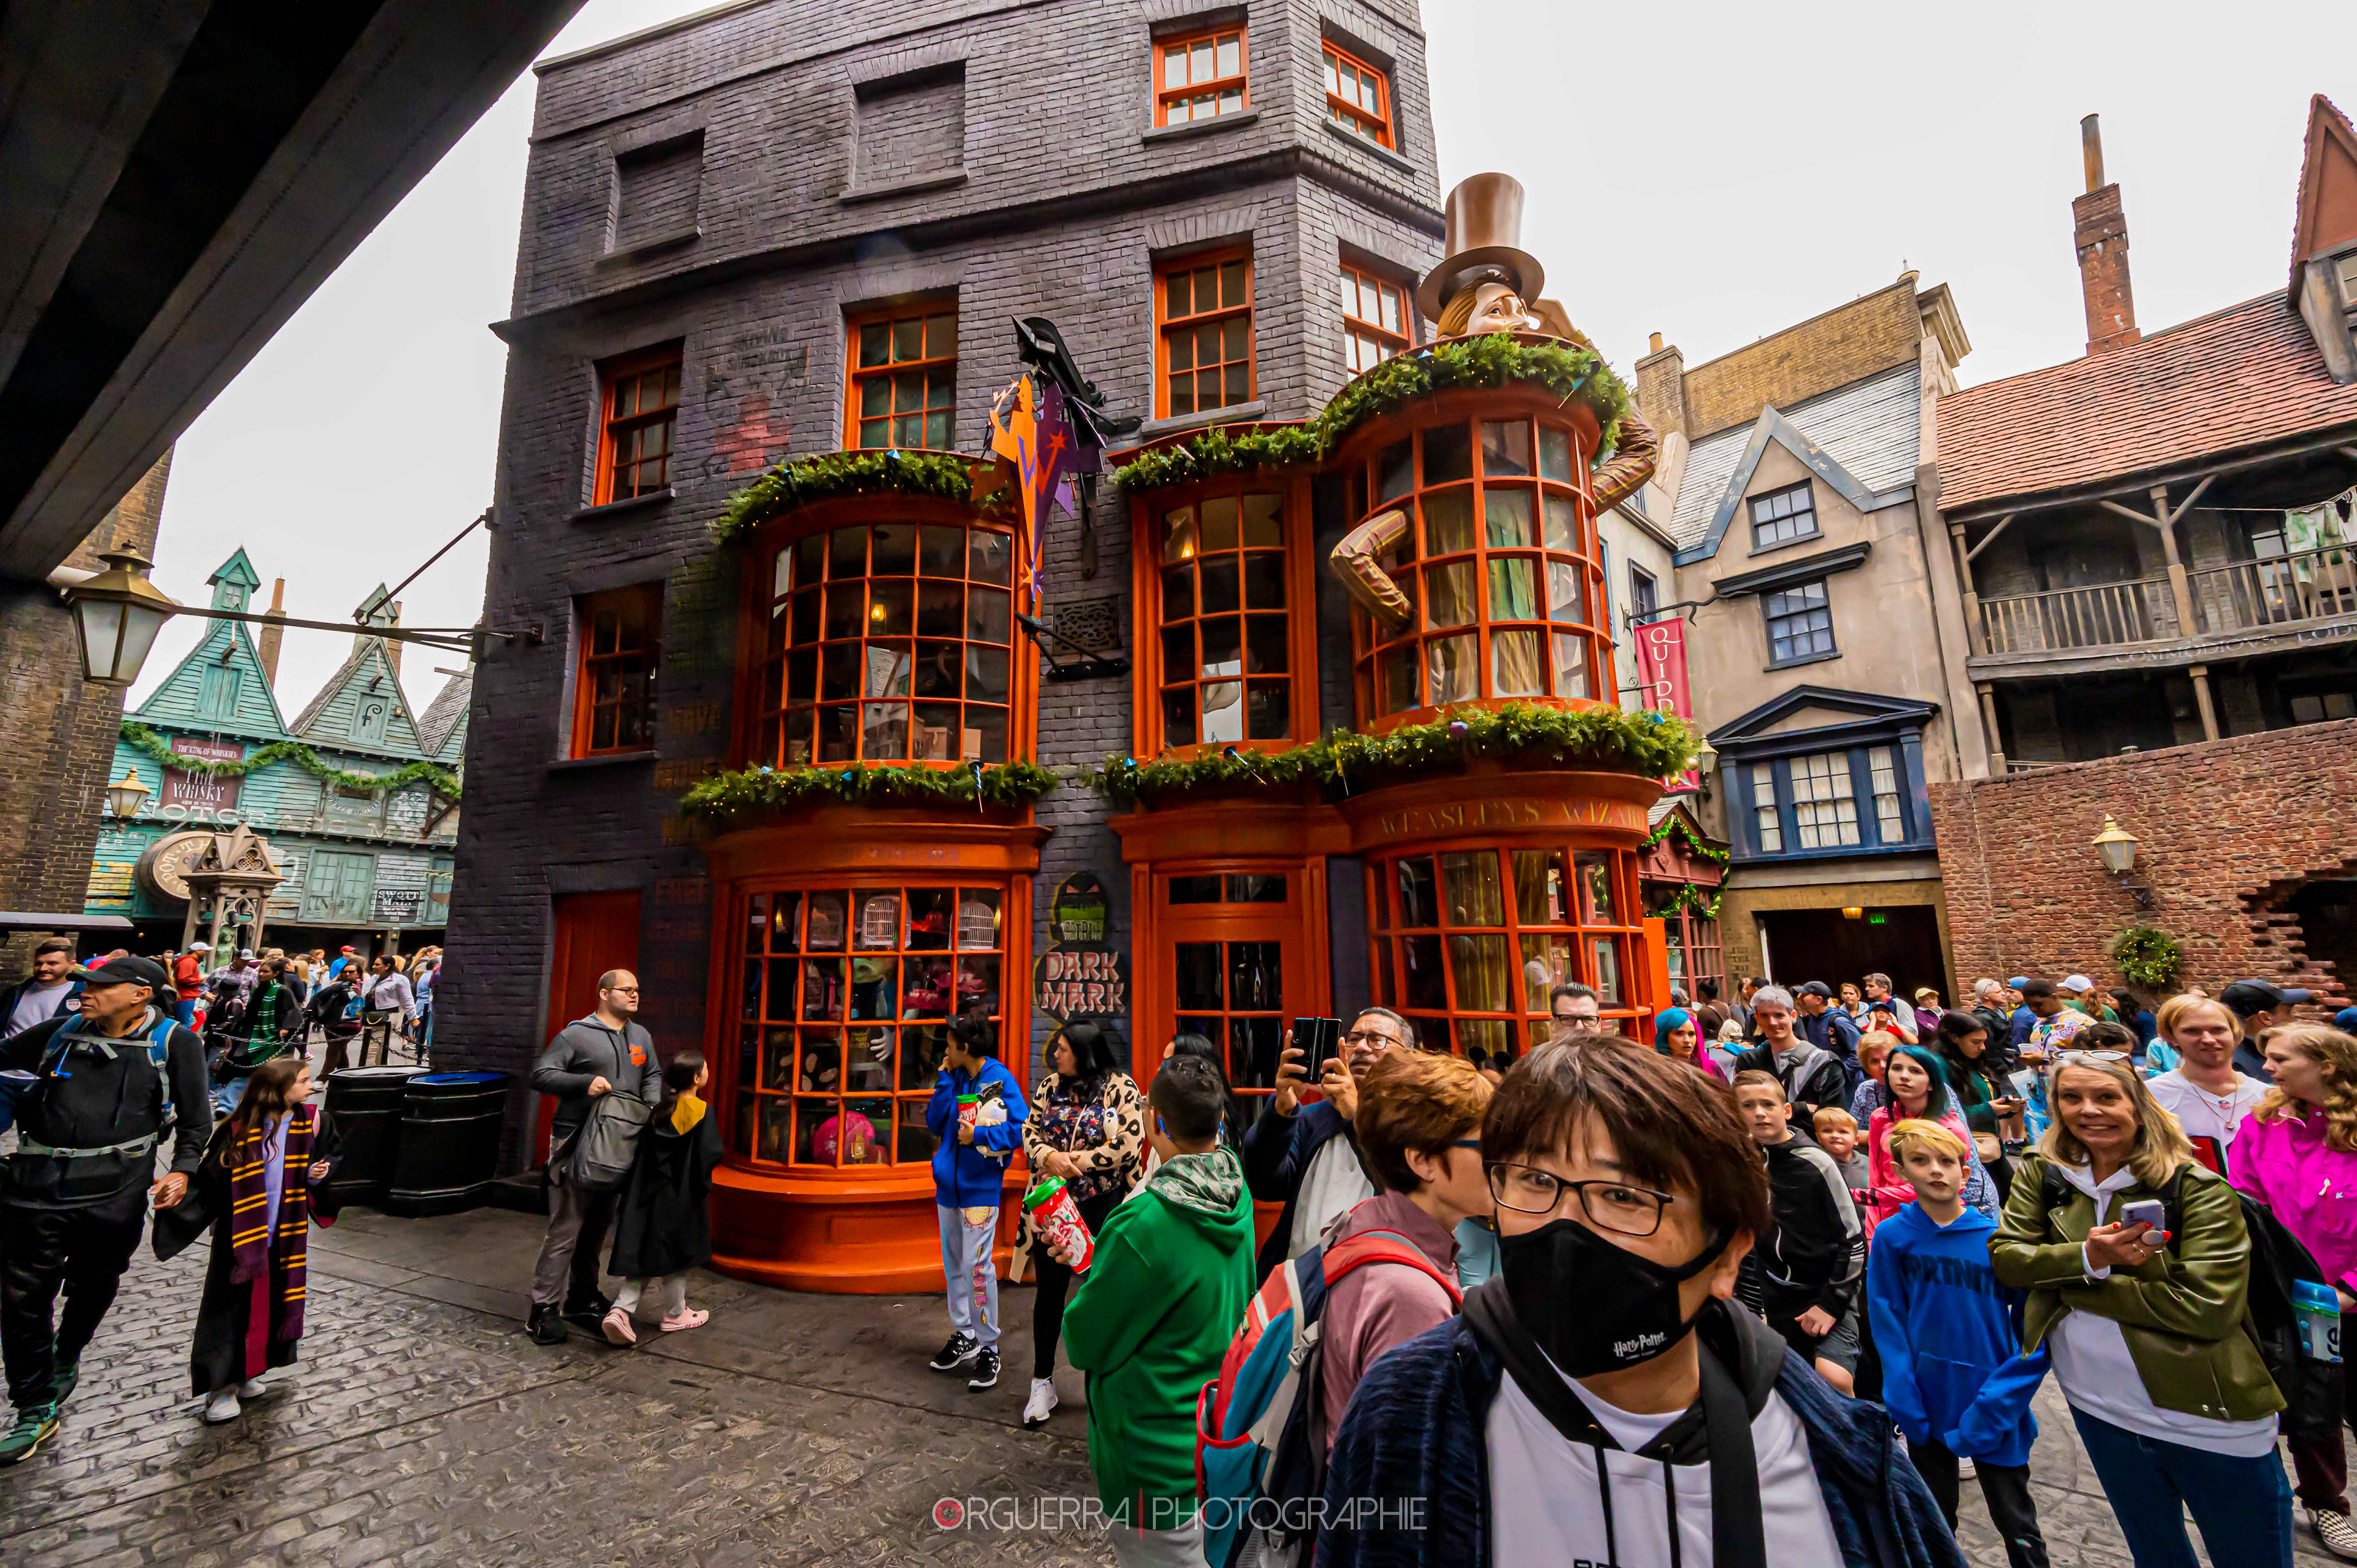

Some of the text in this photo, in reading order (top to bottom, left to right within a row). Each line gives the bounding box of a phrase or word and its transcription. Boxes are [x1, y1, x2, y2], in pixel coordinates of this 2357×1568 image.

[177, 744, 188, 754] THE
[188, 746, 203, 755] KING
[211, 749, 238, 759] WHISKIES
[174, 782, 225, 801] WHISKY
[352, 797, 384, 815] SOOTHERS
[378, 890, 419, 899] SWOTT
[1046, 951, 1120, 983] DARK
[1041, 982, 1126, 1021] MARK
[1613, 1340, 1639, 1358] Harry
[1638, 1332, 1668, 1352] Potter
